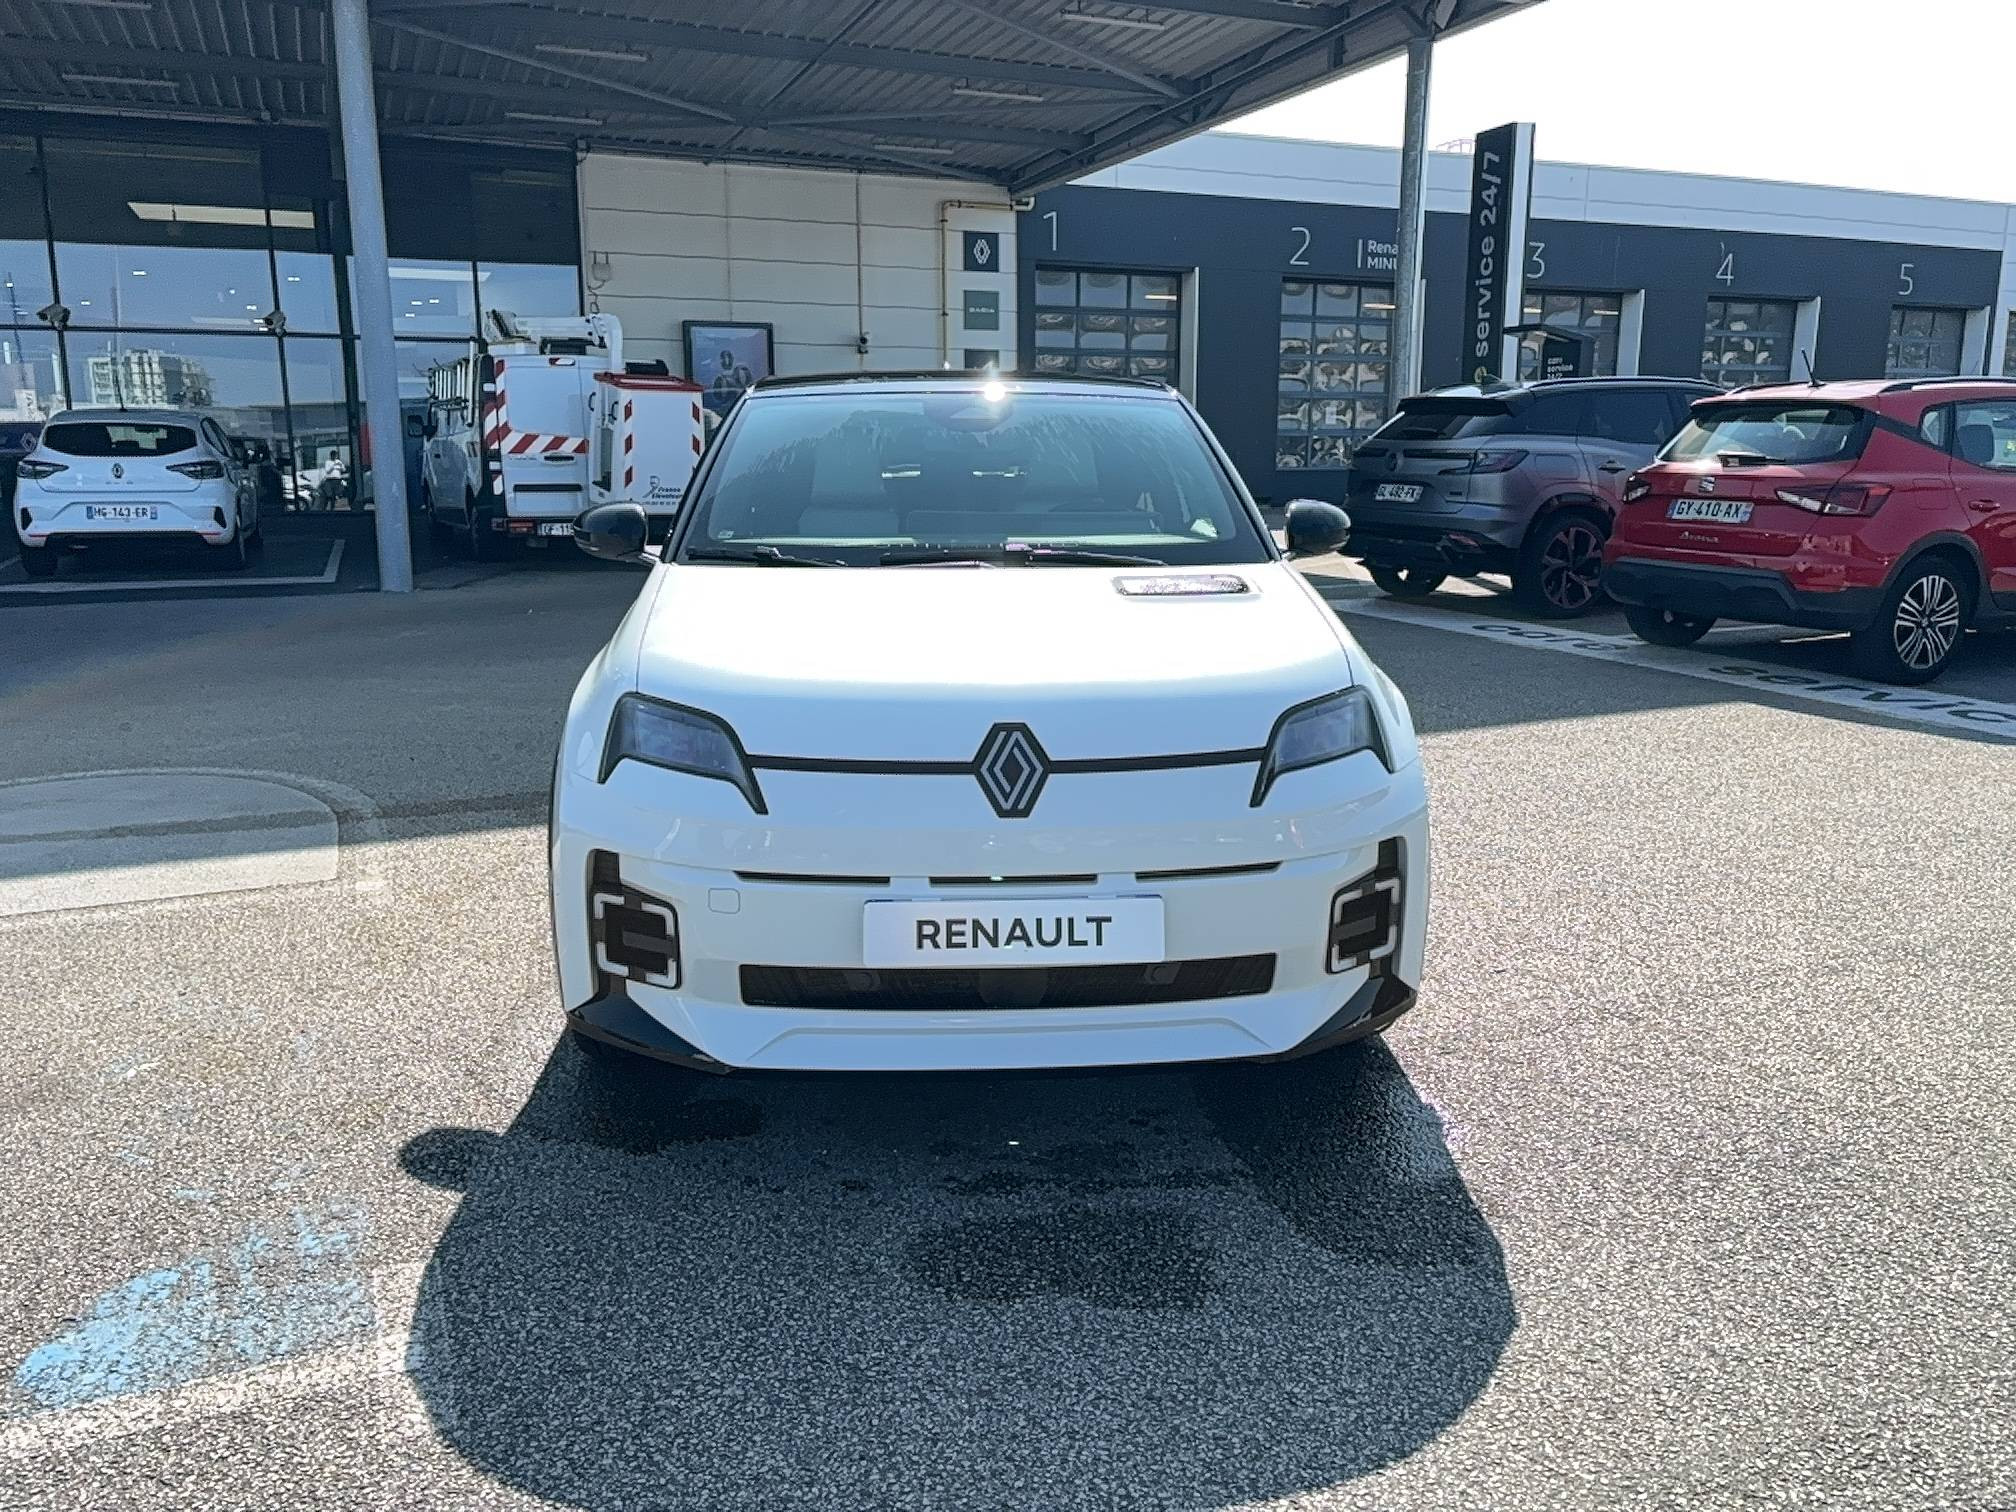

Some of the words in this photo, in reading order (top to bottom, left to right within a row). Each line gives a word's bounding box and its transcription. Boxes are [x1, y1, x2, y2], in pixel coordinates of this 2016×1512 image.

[1480, 151, 1502, 227] 24/7
[1043, 211, 1057, 251] 1
[1290, 227, 1310, 265] 2
[1526, 241, 1546, 279] 3
[1715, 253, 1734, 287] 4
[1475, 235, 1496, 358] service
[1897, 263, 1915, 296] 5
[915, 916, 1112, 950] RENAULT
